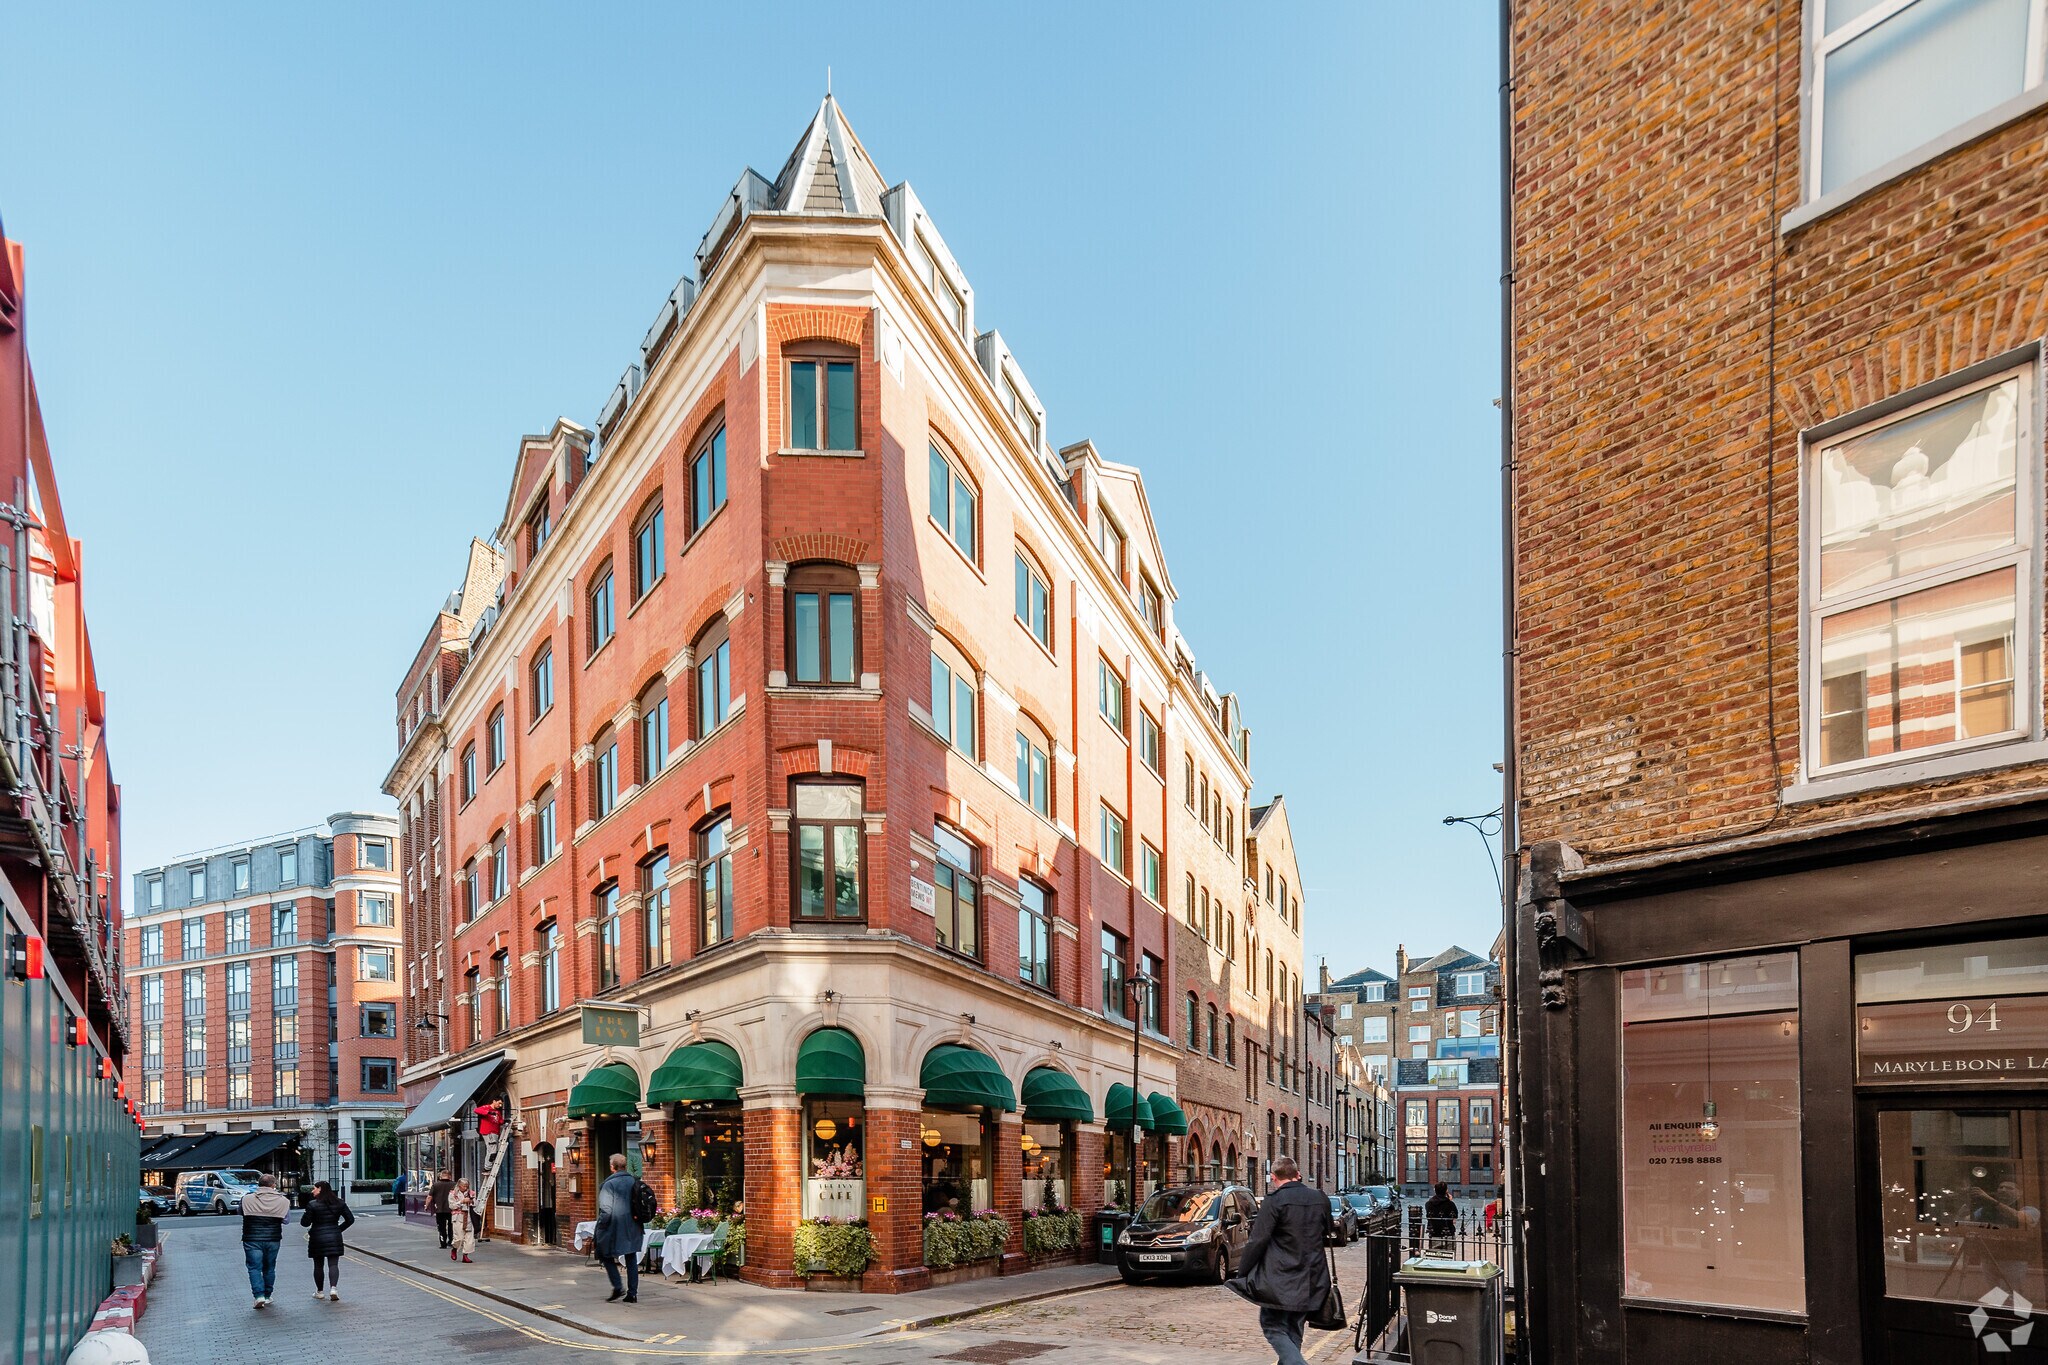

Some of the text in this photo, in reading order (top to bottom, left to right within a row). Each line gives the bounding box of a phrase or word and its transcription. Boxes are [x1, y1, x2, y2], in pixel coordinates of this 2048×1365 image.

[911, 879, 934, 897] BENTINCK
[598, 1015, 624, 1026] THE
[1947, 1001, 2002, 1034] 94
[595, 1025, 630, 1039] IVY
[1873, 1058, 2016, 1074] MARYLEBONE
[1649, 1121, 1719, 1131] All ENQUIRIES
[1653, 1142, 1717, 1155] twentyretail
[1648, 1156, 1722, 1165] 020 7198 8888
[874, 1198, 886, 1211] H
[1438, 1313, 1458, 1321] Dorset
